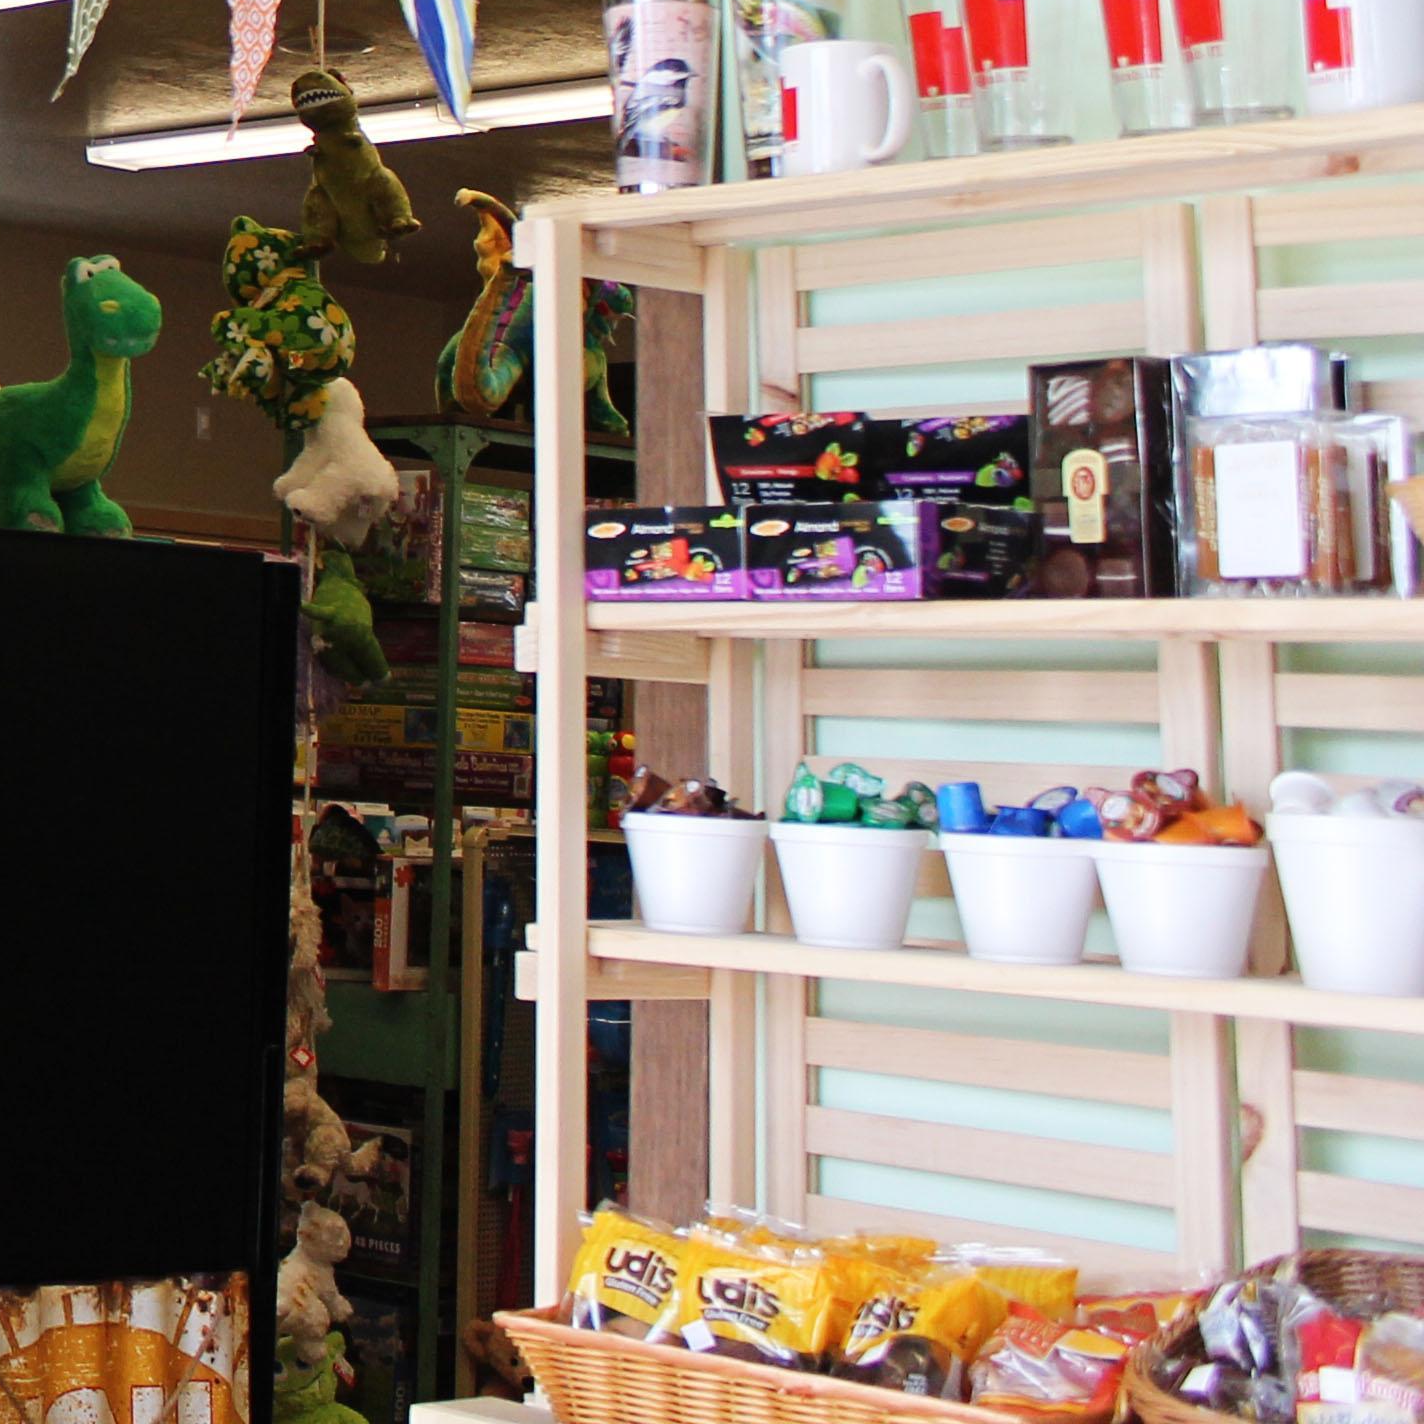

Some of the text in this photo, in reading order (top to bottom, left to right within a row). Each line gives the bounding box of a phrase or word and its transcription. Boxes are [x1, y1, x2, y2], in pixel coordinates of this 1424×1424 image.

[368, 1236, 402, 1255] PIECES
[604, 1245, 678, 1295] udi's
[697, 1275, 781, 1318] udi's
